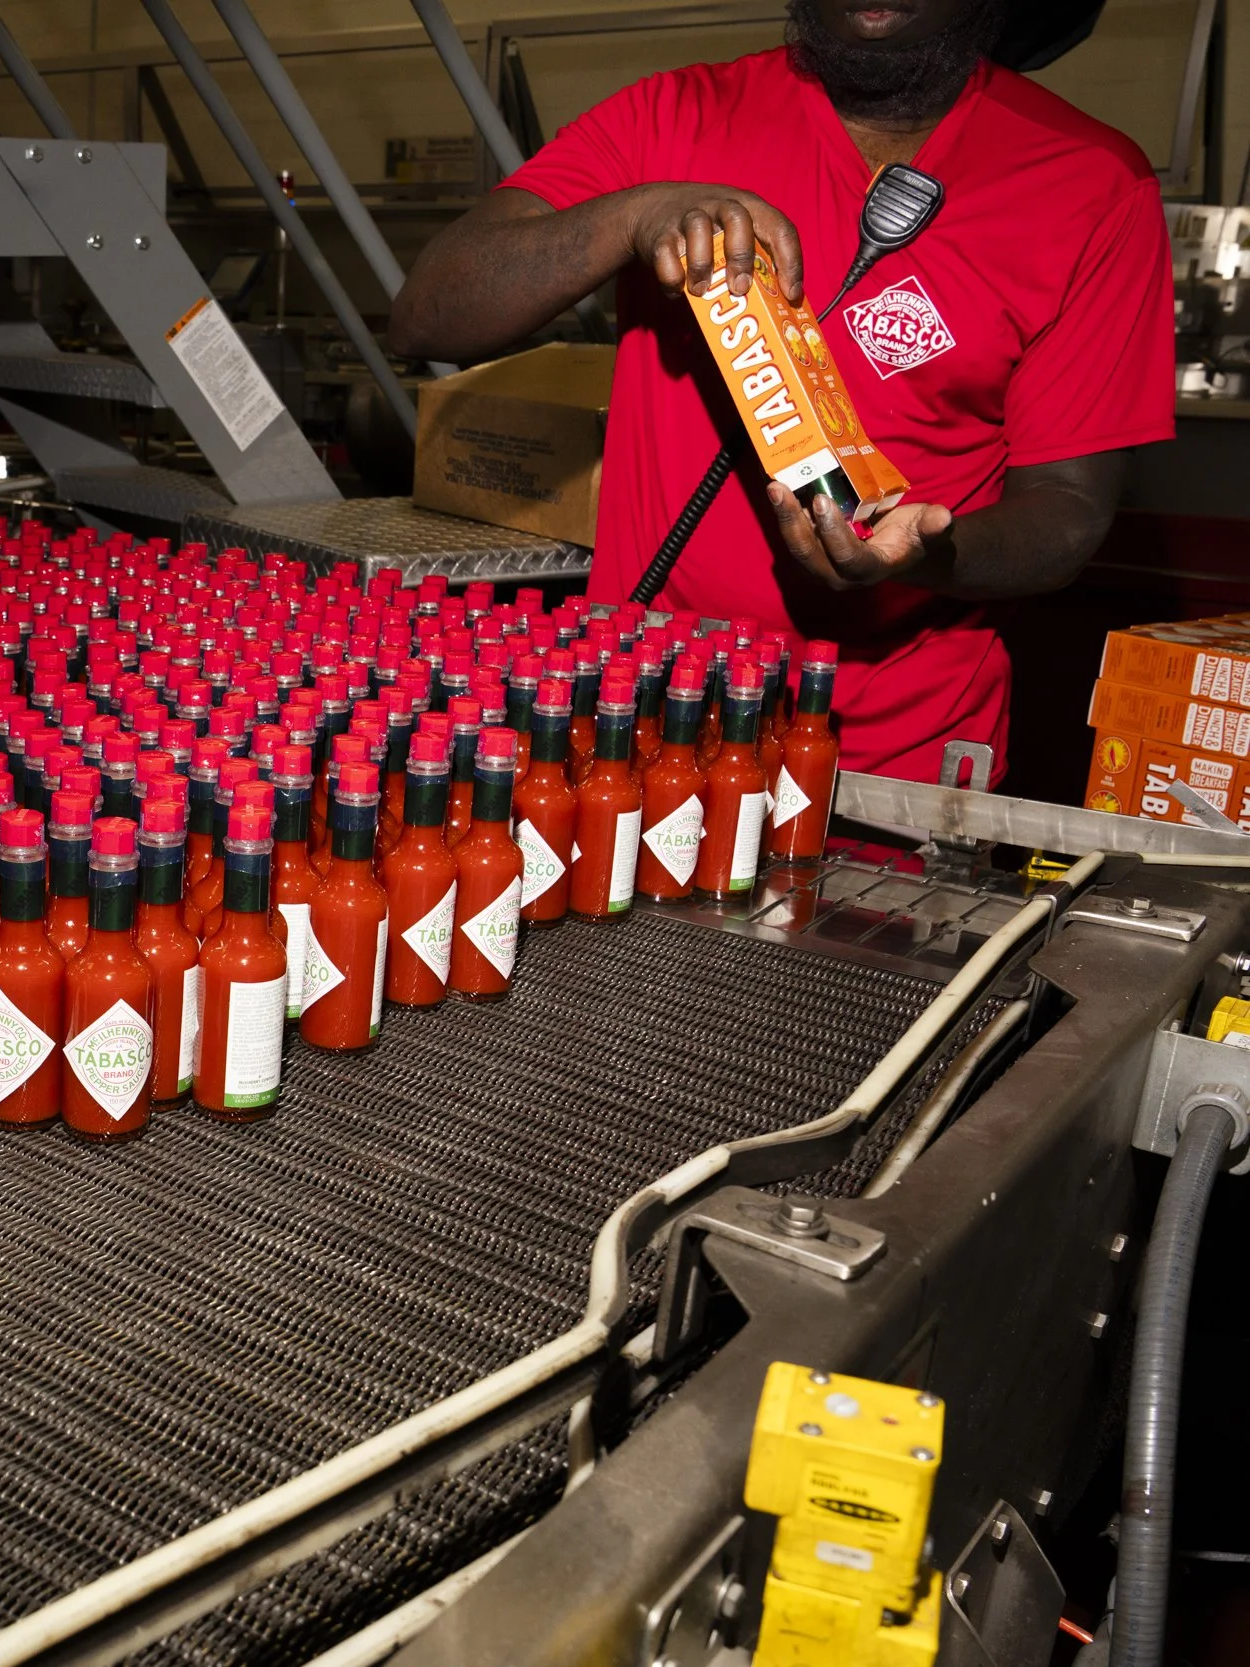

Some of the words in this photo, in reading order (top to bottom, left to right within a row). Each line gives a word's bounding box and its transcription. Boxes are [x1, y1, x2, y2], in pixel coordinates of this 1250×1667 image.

[852, 306, 948, 351] TABASCO
[859, 330, 890, 361] PEPPER
[891, 346, 927, 366] SAUCE
[875, 337, 908, 353] BRAND
[1199, 655, 1219, 697] DINNER
[1191, 704, 1211, 746] DINNER
[1189, 773, 1230, 789] BREAKFAST
[1194, 761, 1230, 776] MAKING
[75, 1041, 152, 1068] TABASCO
[0, 1057, 27, 1080] SAUCE
[86, 1067, 120, 1094] PEPPER
[122, 1064, 145, 1093] SAUCE
[103, 1069, 134, 1080] BRAND
